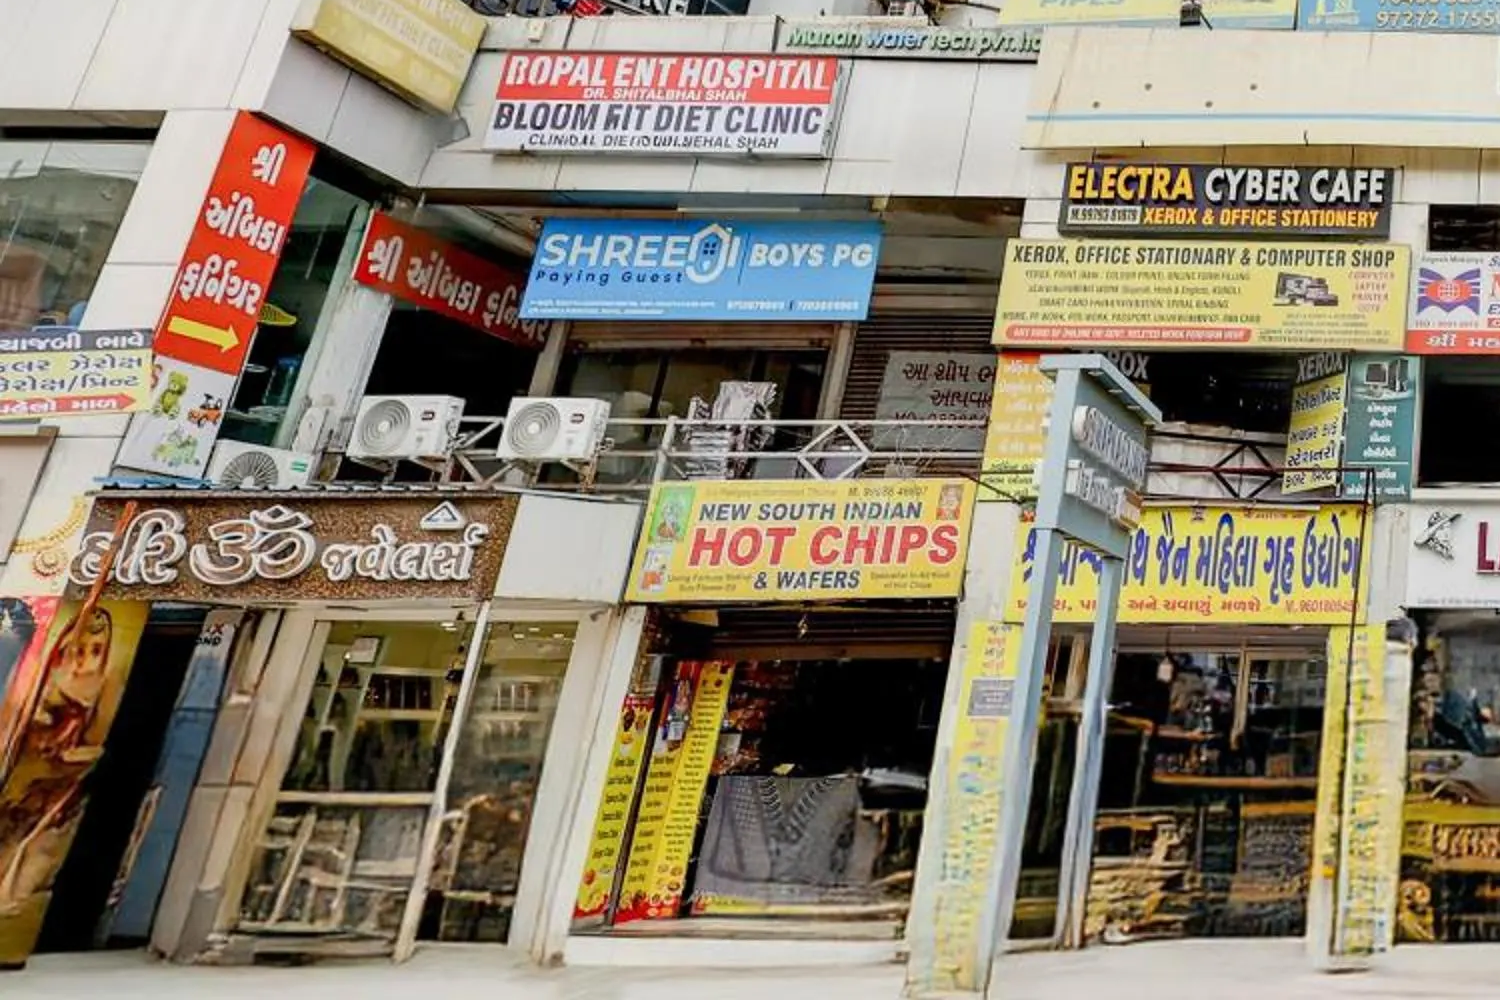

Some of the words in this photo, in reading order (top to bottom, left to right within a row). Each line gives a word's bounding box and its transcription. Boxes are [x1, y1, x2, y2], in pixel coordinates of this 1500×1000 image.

[505, 55, 605, 87] ROPAL
[612, 57, 676, 88] ENT
[678, 57, 832, 90] HOSPITAL
[653, 104, 723, 134] DIET
[724, 105, 824, 135] CLINIC
[250, 142, 287, 187] શ્રી
[1068, 165, 1194, 201] ELECTRA
[1204, 167, 1302, 203] CYBER
[1309, 168, 1386, 204] CAFE
[204, 189, 290, 258] અંબિકા
[1143, 207, 1198, 226] XEROX
[1201, 207, 1214, 226] &
[1220, 208, 1278, 227] OFFICE
[1280, 208, 1380, 230] STATIONERY
[366, 235, 405, 284] શ્રી
[749, 243, 824, 267] BOYS
[831, 243, 873, 268] PG
[1011, 245, 1070, 266] XEROX,
[1074, 246, 1132, 266] OFFICE
[1135, 246, 1236, 267] STATIONARY
[1239, 247, 1252, 267] &
[1255, 247, 1349, 268] COMPUTER
[1350, 248, 1397, 269] SHOP
[534, 270, 610, 287] Paying
[699, 502, 751, 521] NEW
[757, 502, 836, 521] SOUTH
[843, 501, 924, 521] INDIAN
[67, 507, 187, 587] હરિ
[687, 526, 798, 568] HOT
[808, 524, 960, 567] CHIPS
[1195, 513, 1258, 595] મહિલા
[752, 571, 768, 591] &
[776, 569, 862, 590] WAFERS
[1127, 597, 1158, 612] અને
